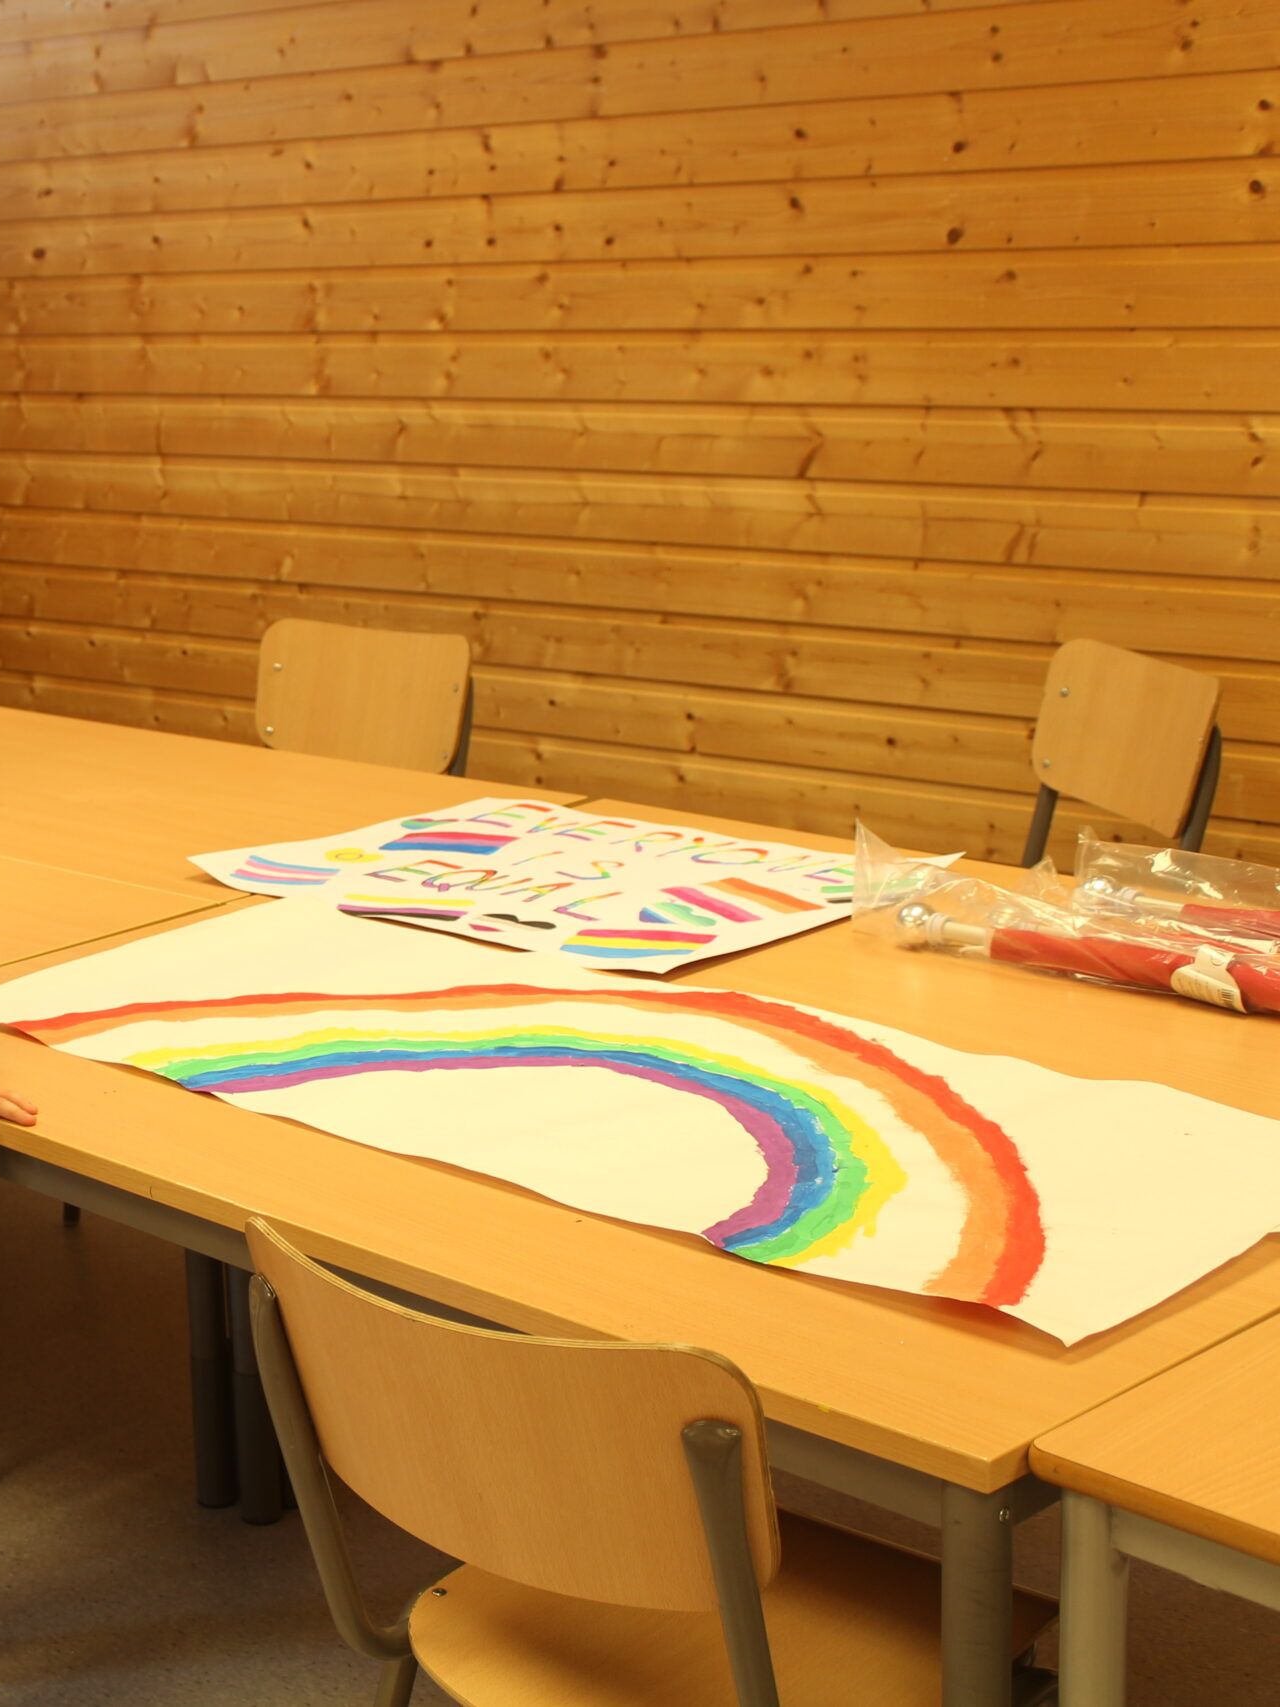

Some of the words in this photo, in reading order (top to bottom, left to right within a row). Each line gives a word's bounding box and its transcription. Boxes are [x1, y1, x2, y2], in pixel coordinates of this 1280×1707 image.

[465, 803, 857, 884] EVERYONE
[511, 850, 626, 881] IS
[363, 859, 624, 922] EQUAL
